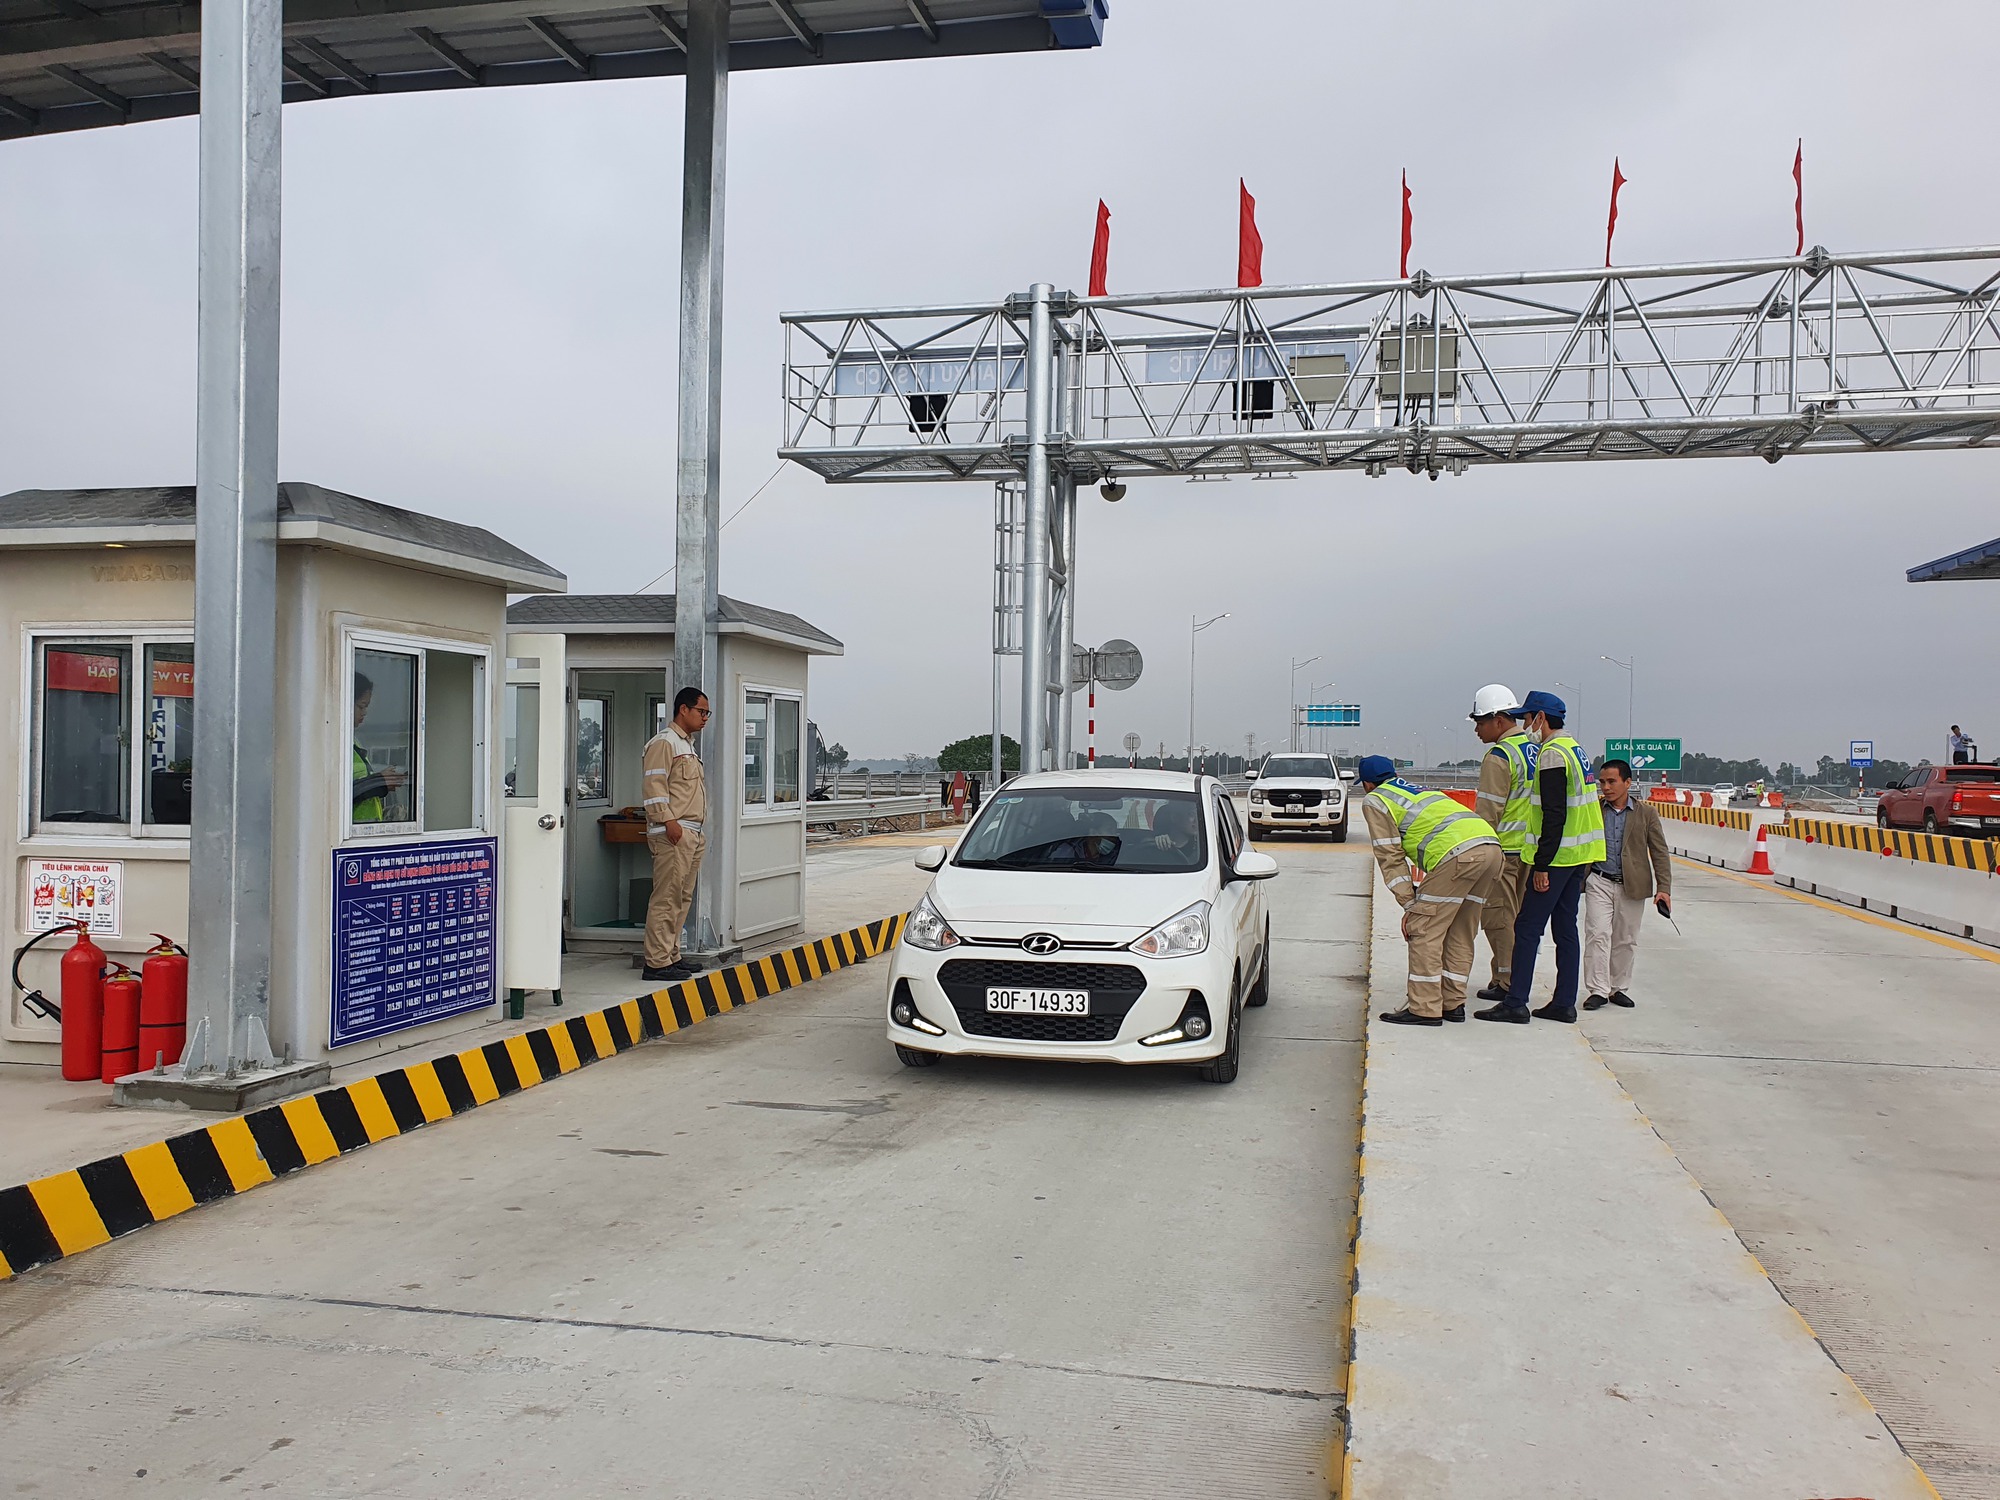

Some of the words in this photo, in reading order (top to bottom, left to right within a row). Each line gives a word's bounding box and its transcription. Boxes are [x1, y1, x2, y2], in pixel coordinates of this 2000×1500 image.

[1610, 742, 1622, 750] LỐI
[1647, 742, 1662, 750] QUÁ
[990, 990, 1086, 1012] 30F-149.33
